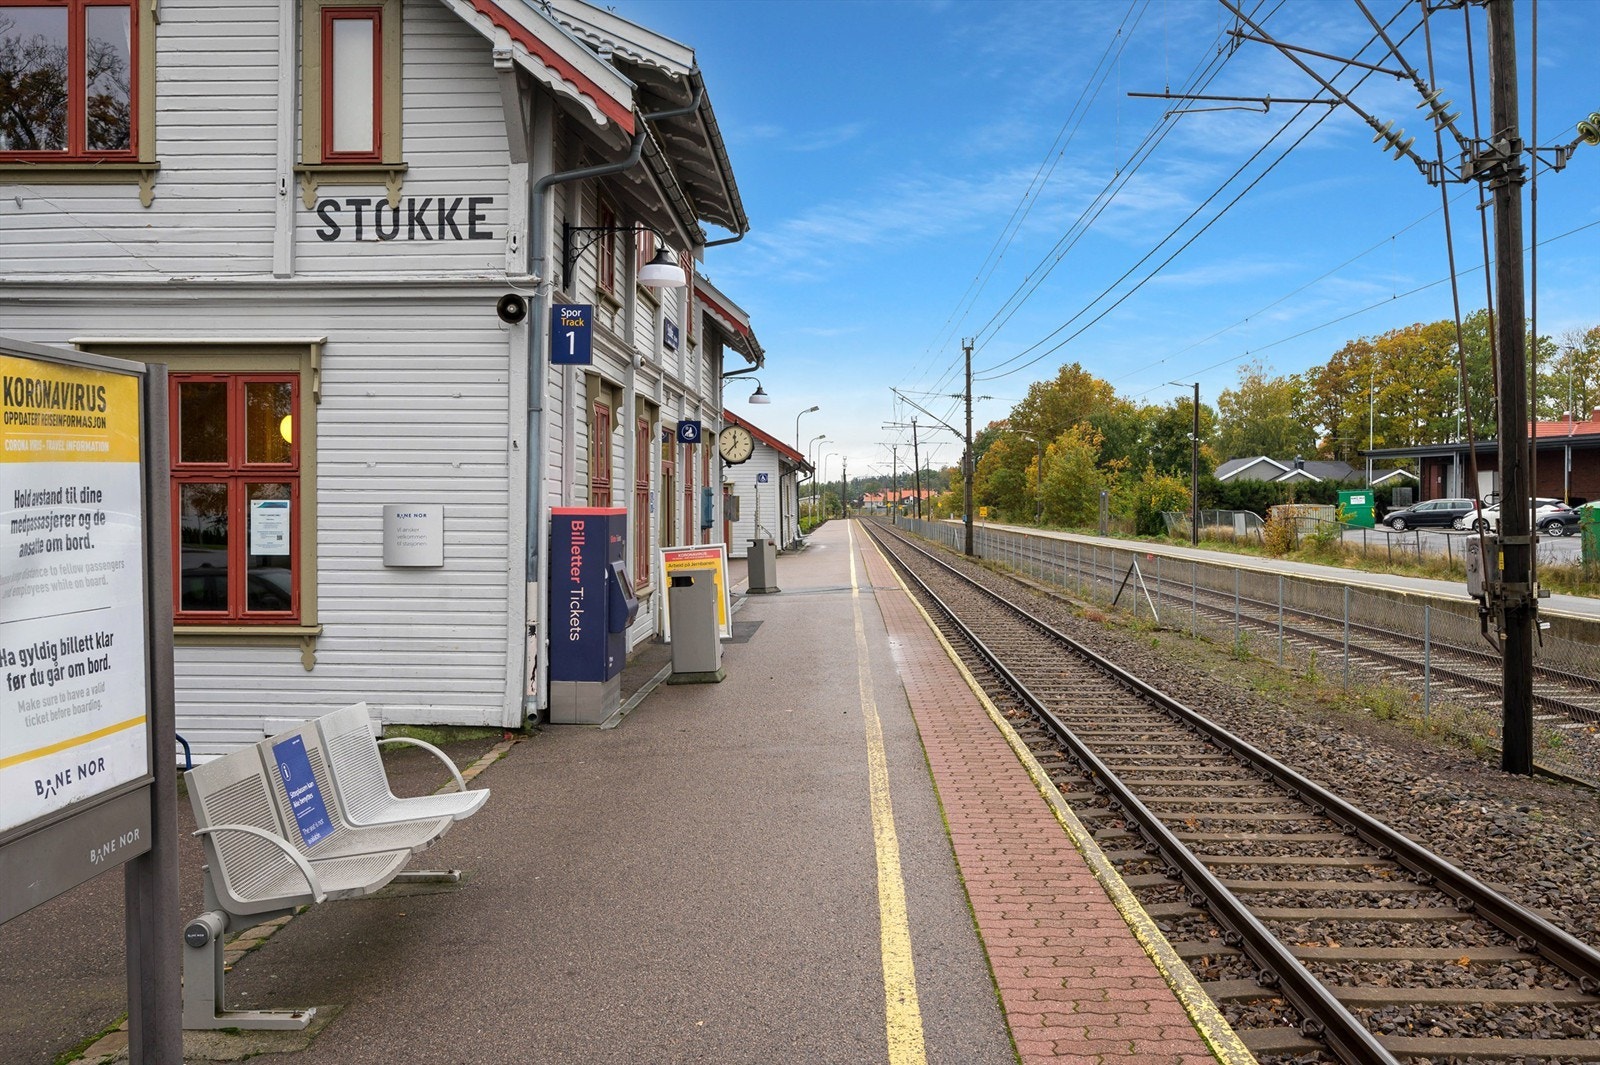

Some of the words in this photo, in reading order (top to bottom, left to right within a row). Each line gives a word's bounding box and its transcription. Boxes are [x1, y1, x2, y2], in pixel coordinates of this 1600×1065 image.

[316, 197, 493, 241] STOKKE
[561, 307, 582, 318] Spor
[561, 318, 584, 327] Track
[566, 331, 576, 355] 1
[3, 376, 107, 413] KORONAVIRUS
[4, 411, 41, 426] OPPDATERT
[41, 413, 107, 429] REISEINFORMASJON
[66, 441, 109, 453] INFORMATION
[14, 489, 31, 509] Hold
[32, 487, 62, 506] avstand
[65, 487, 77, 504] til
[80, 486, 102, 503] dine
[11, 511, 76, 536] medpassasjerer
[79, 513, 91, 530] og
[93, 509, 106, 526] de
[46, 538, 63, 553] om
[65, 532, 95, 551] bord.
[570, 520, 585, 583] Billetter
[49, 565, 58, 576] to
[59, 562, 84, 575] fellow
[85, 560, 125, 574] passengers
[50, 579, 73, 592] while
[74, 578, 84, 589] on
[85, 574, 109, 587] board.
[569, 587, 585, 641] Tickets
[0, 648, 17, 668] Ha
[19, 641, 58, 668] gyldig
[60, 634, 94, 656] billett
[95, 631, 114, 650] klar
[6, 672, 27, 692] før
[30, 668, 45, 687] du
[46, 661, 65, 687] går
[68, 661, 86, 679] om
[87, 653, 111, 675] bord.
[17, 698, 41, 714] Make
[42, 693, 59, 708] sure
[59, 692, 66, 703] to
[66, 688, 85, 701] have
[85, 687, 91, 697] a
[91, 681, 106, 696] valid
[24, 712, 50, 728] ticket
[50, 707, 71, 721] before
[72, 699, 103, 716] boarding.
[34, 769, 72, 799] BANE
[77, 757, 105, 780] NOR
[90, 839, 116, 865] BANE
[119, 828, 140, 848] NOR
